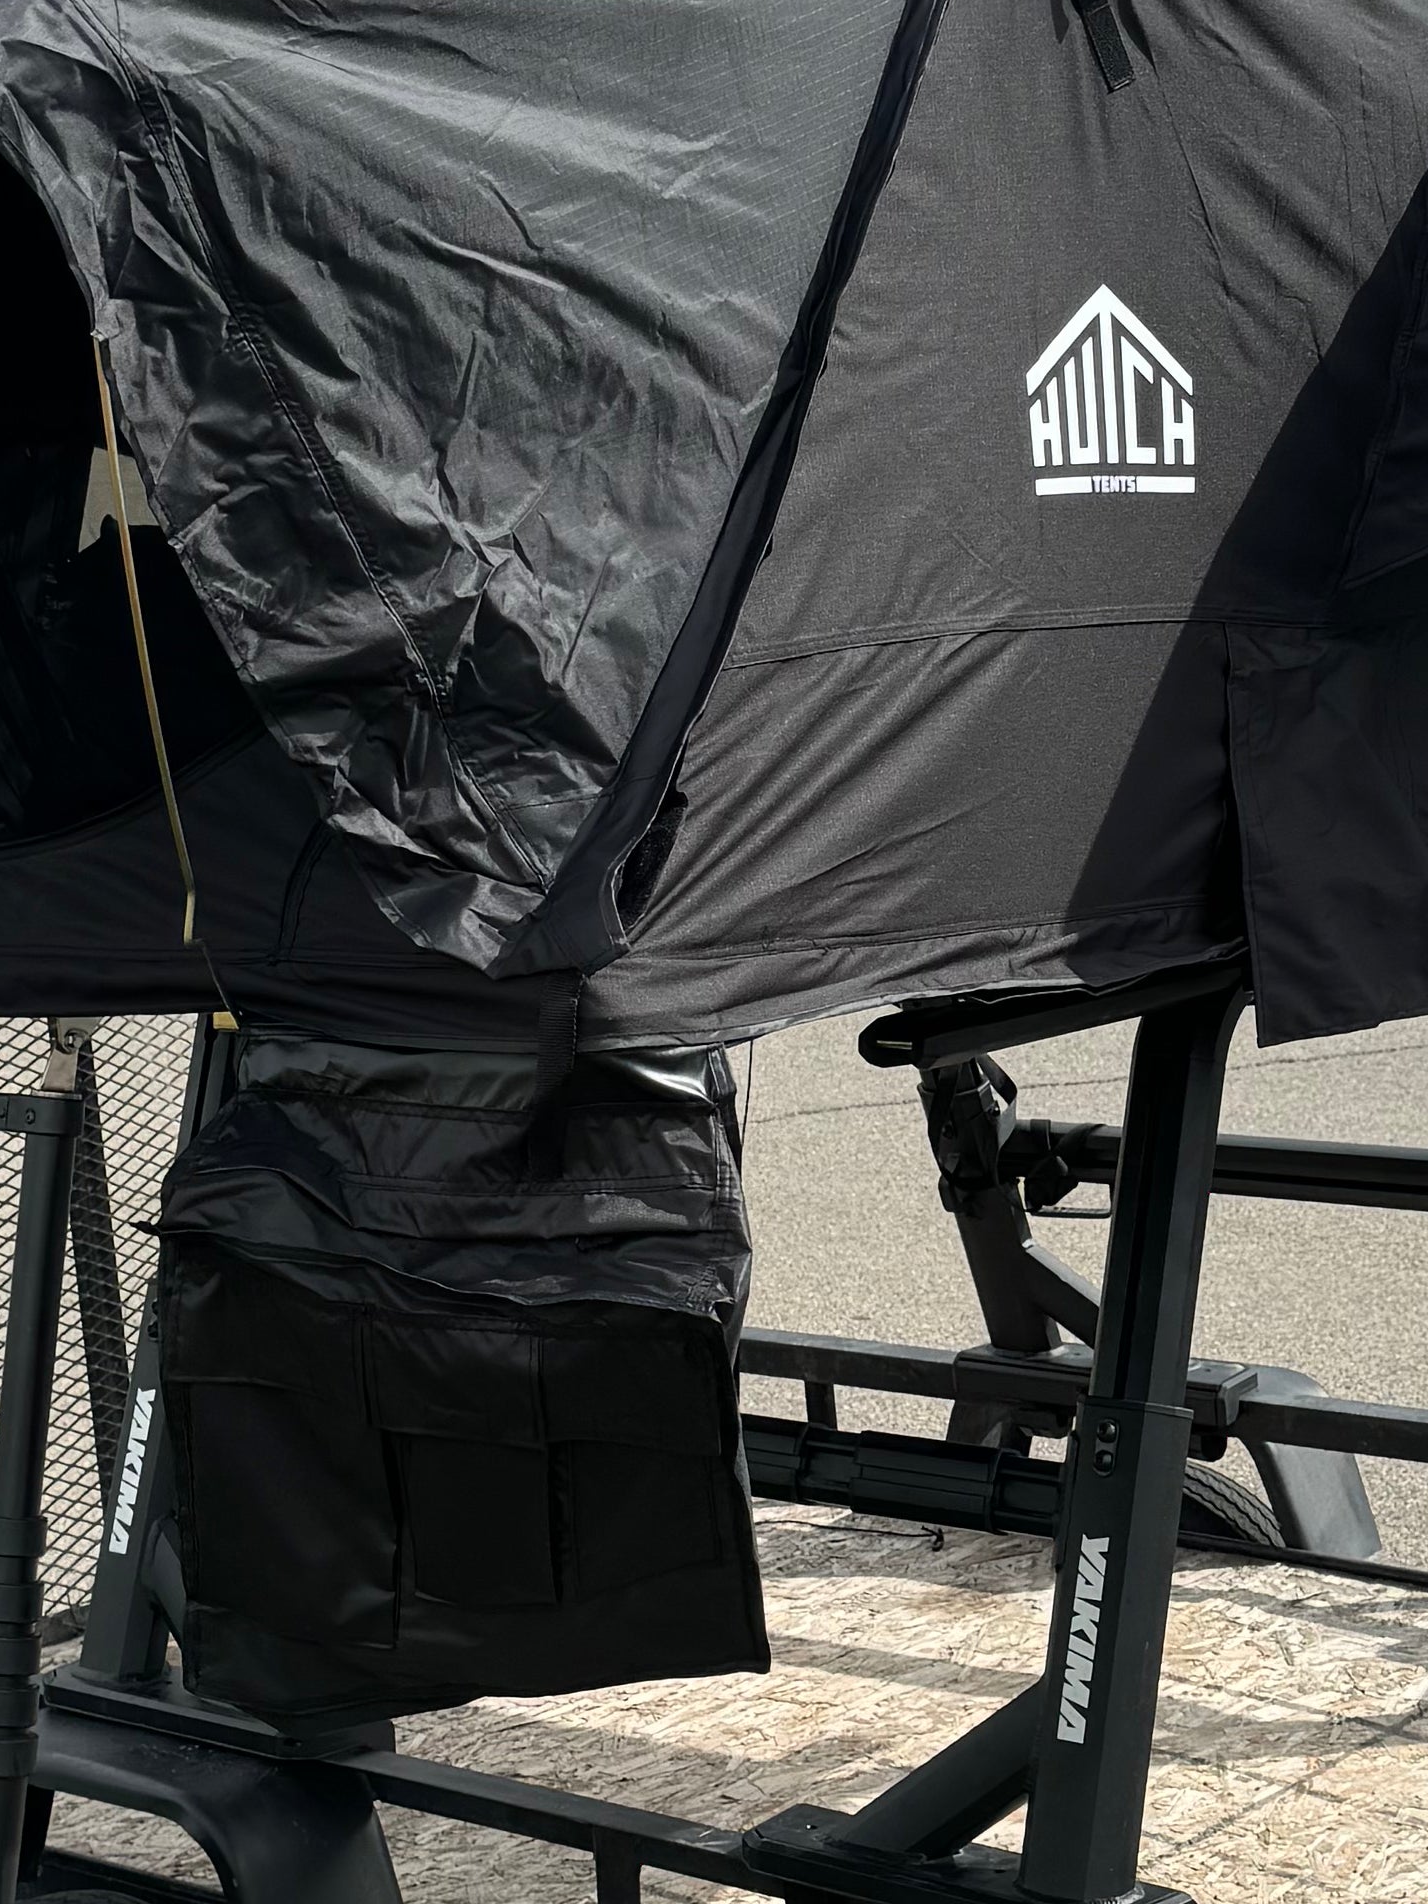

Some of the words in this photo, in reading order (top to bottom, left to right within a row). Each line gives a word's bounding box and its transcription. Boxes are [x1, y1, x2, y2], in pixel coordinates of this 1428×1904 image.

[1025, 283, 1196, 467] HUTCH
[1091, 475, 1136, 494] TENTS
[108, 1387, 157, 1555] YAKIMA
[1056, 1533, 1110, 1745] YAKIMA
